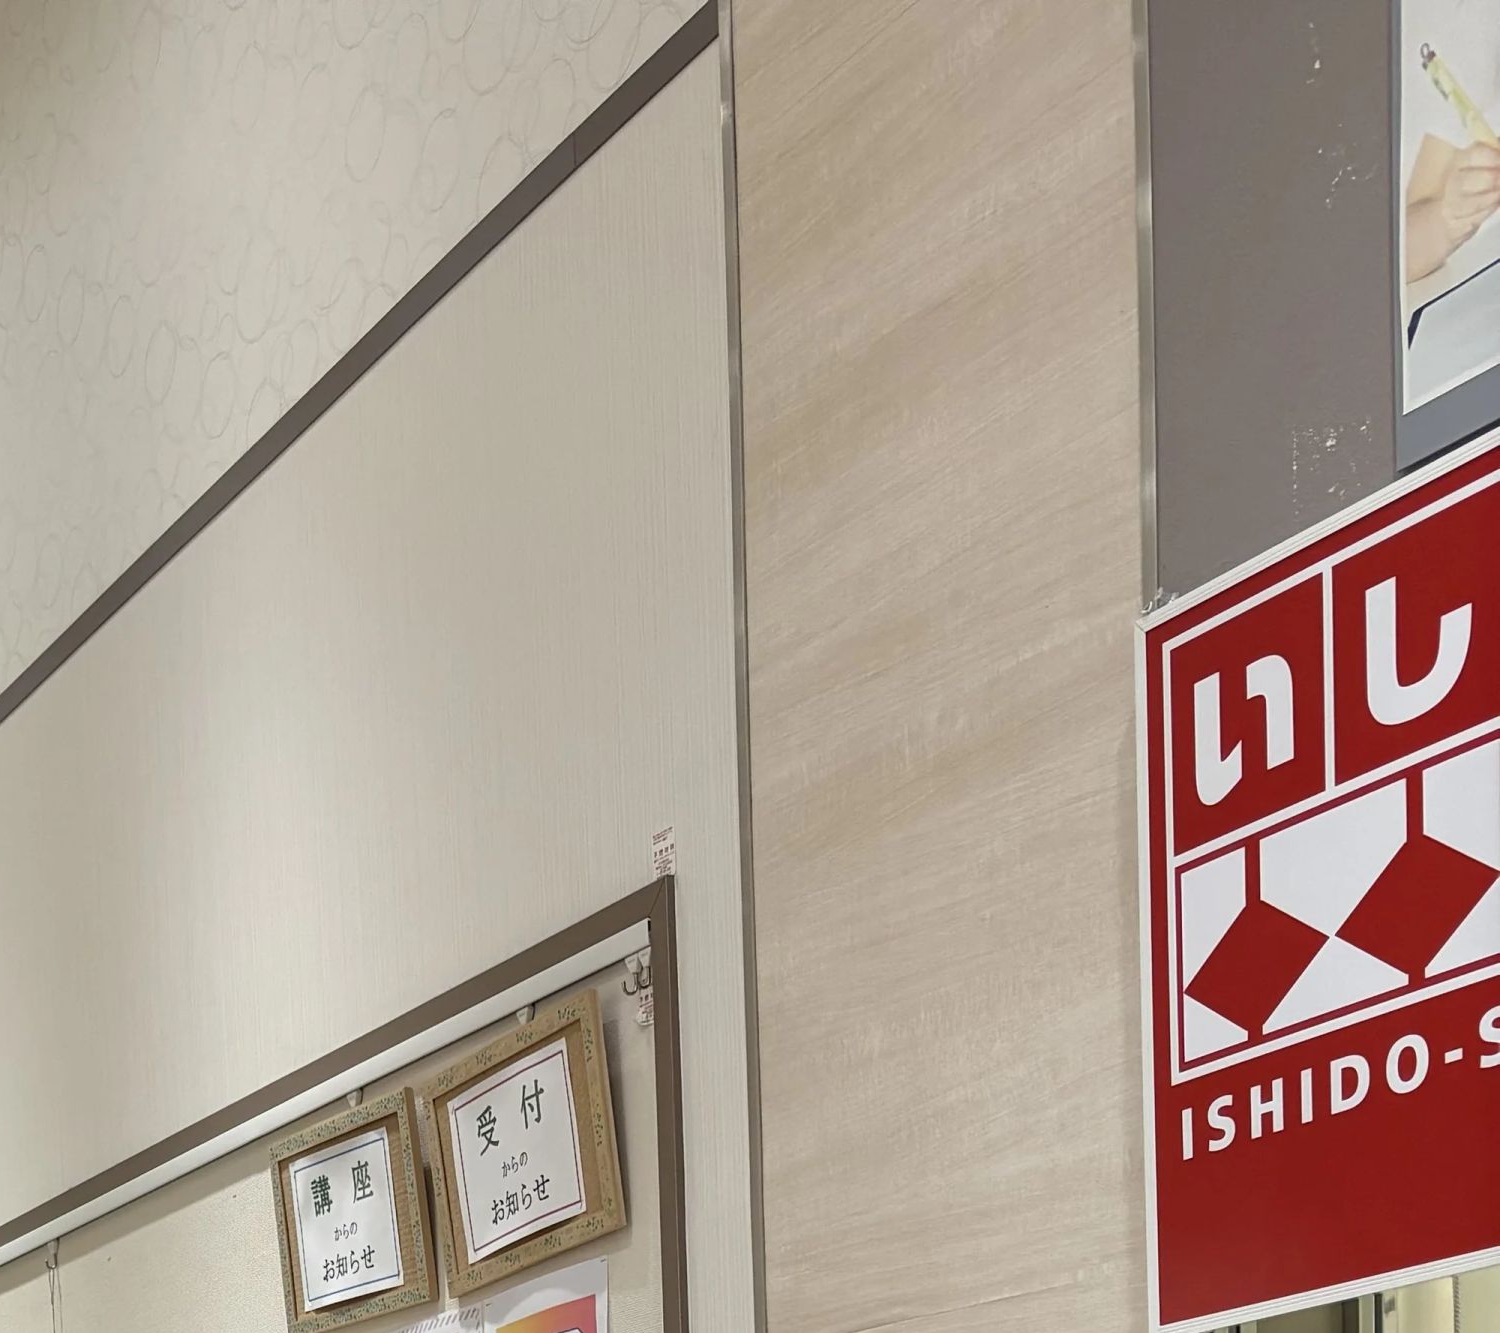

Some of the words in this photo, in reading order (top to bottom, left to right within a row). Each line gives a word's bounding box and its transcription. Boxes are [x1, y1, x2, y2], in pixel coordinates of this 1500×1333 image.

[476, 1079, 544, 1156] 受付
[502, 1151, 528, 1178] からの
[311, 1160, 373, 1217] 講座
[491, 1174, 551, 1226] お知らせ
[334, 1222, 358, 1242] からの
[322, 1245, 375, 1282] お知らせ
